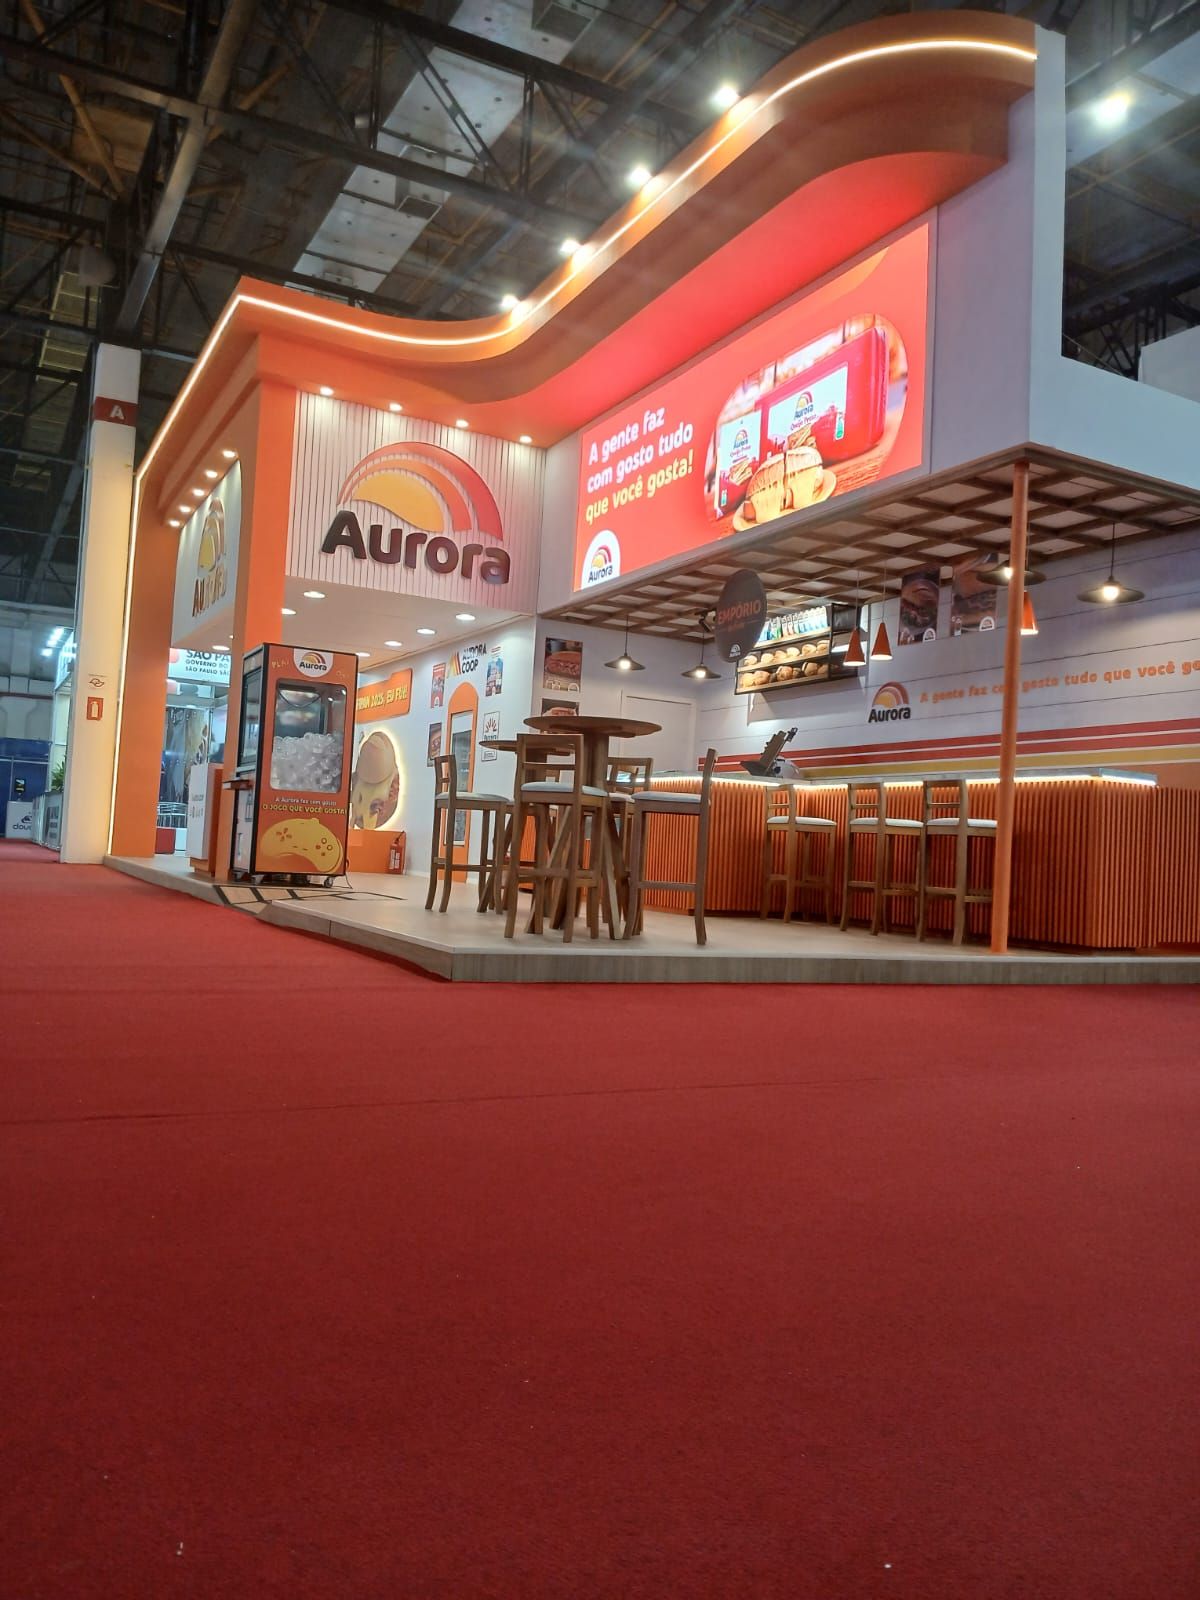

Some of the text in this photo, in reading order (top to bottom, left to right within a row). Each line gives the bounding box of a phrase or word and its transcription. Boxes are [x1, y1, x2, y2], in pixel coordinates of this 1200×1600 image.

[109, 405, 125, 420] A
[588, 407, 666, 466] A gente faz
[587, 422, 694, 494] com gosto tudo
[585, 449, 694, 525] que você gosta!
[320, 509, 511, 585] Aurora
[588, 564, 614, 583] Aurora
[186, 659, 217, 667] GOVERNO
[299, 661, 328, 671] Aurora
[461, 659, 479, 674] COOP
[920, 692, 929, 703] A
[932, 689, 964, 704] gente
[969, 685, 988, 697] faz
[1022, 677, 1059, 693] gosto
[1064, 671, 1098, 686] tudo
[1103, 669, 1131, 683] que
[1138, 661, 1175, 678] você
[868, 707, 912, 723] Aurora
